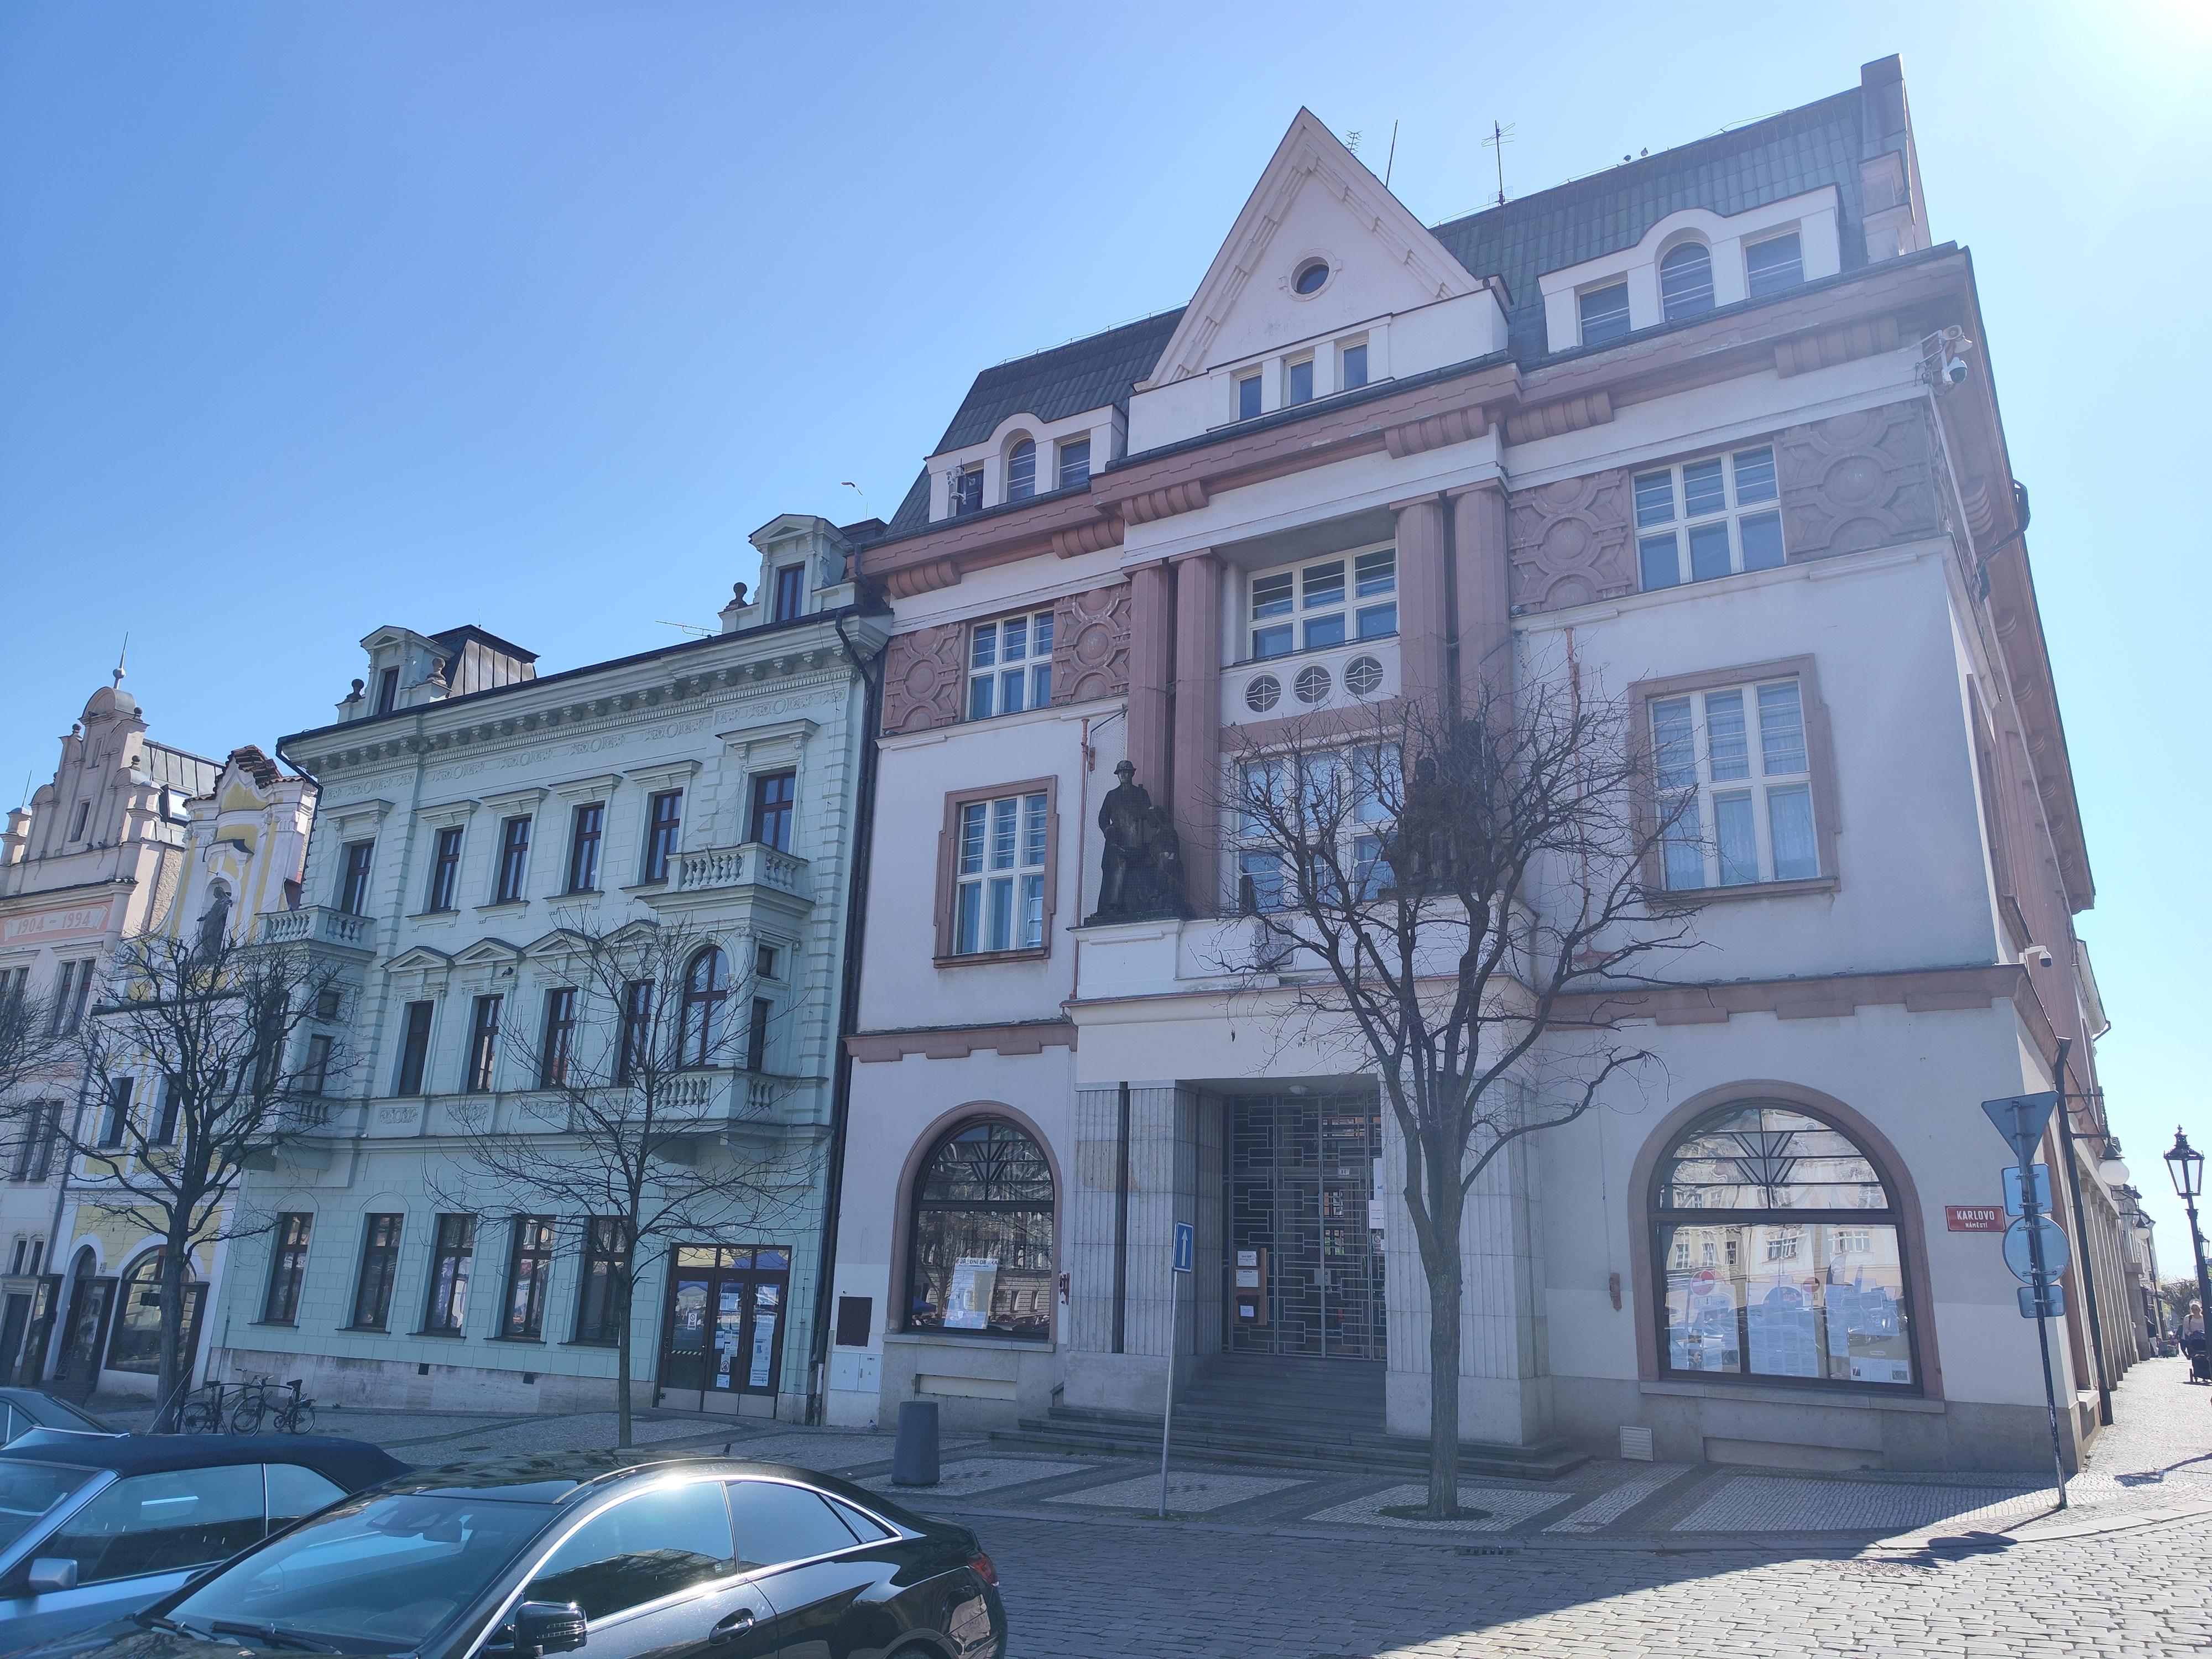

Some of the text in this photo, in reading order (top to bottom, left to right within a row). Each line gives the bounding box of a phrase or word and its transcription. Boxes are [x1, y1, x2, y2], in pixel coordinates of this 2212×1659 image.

[17, 916, 45, 935] 1904
[62, 911, 91, 929] 1994
[1957, 1211, 1995, 1220] KARLOVO
